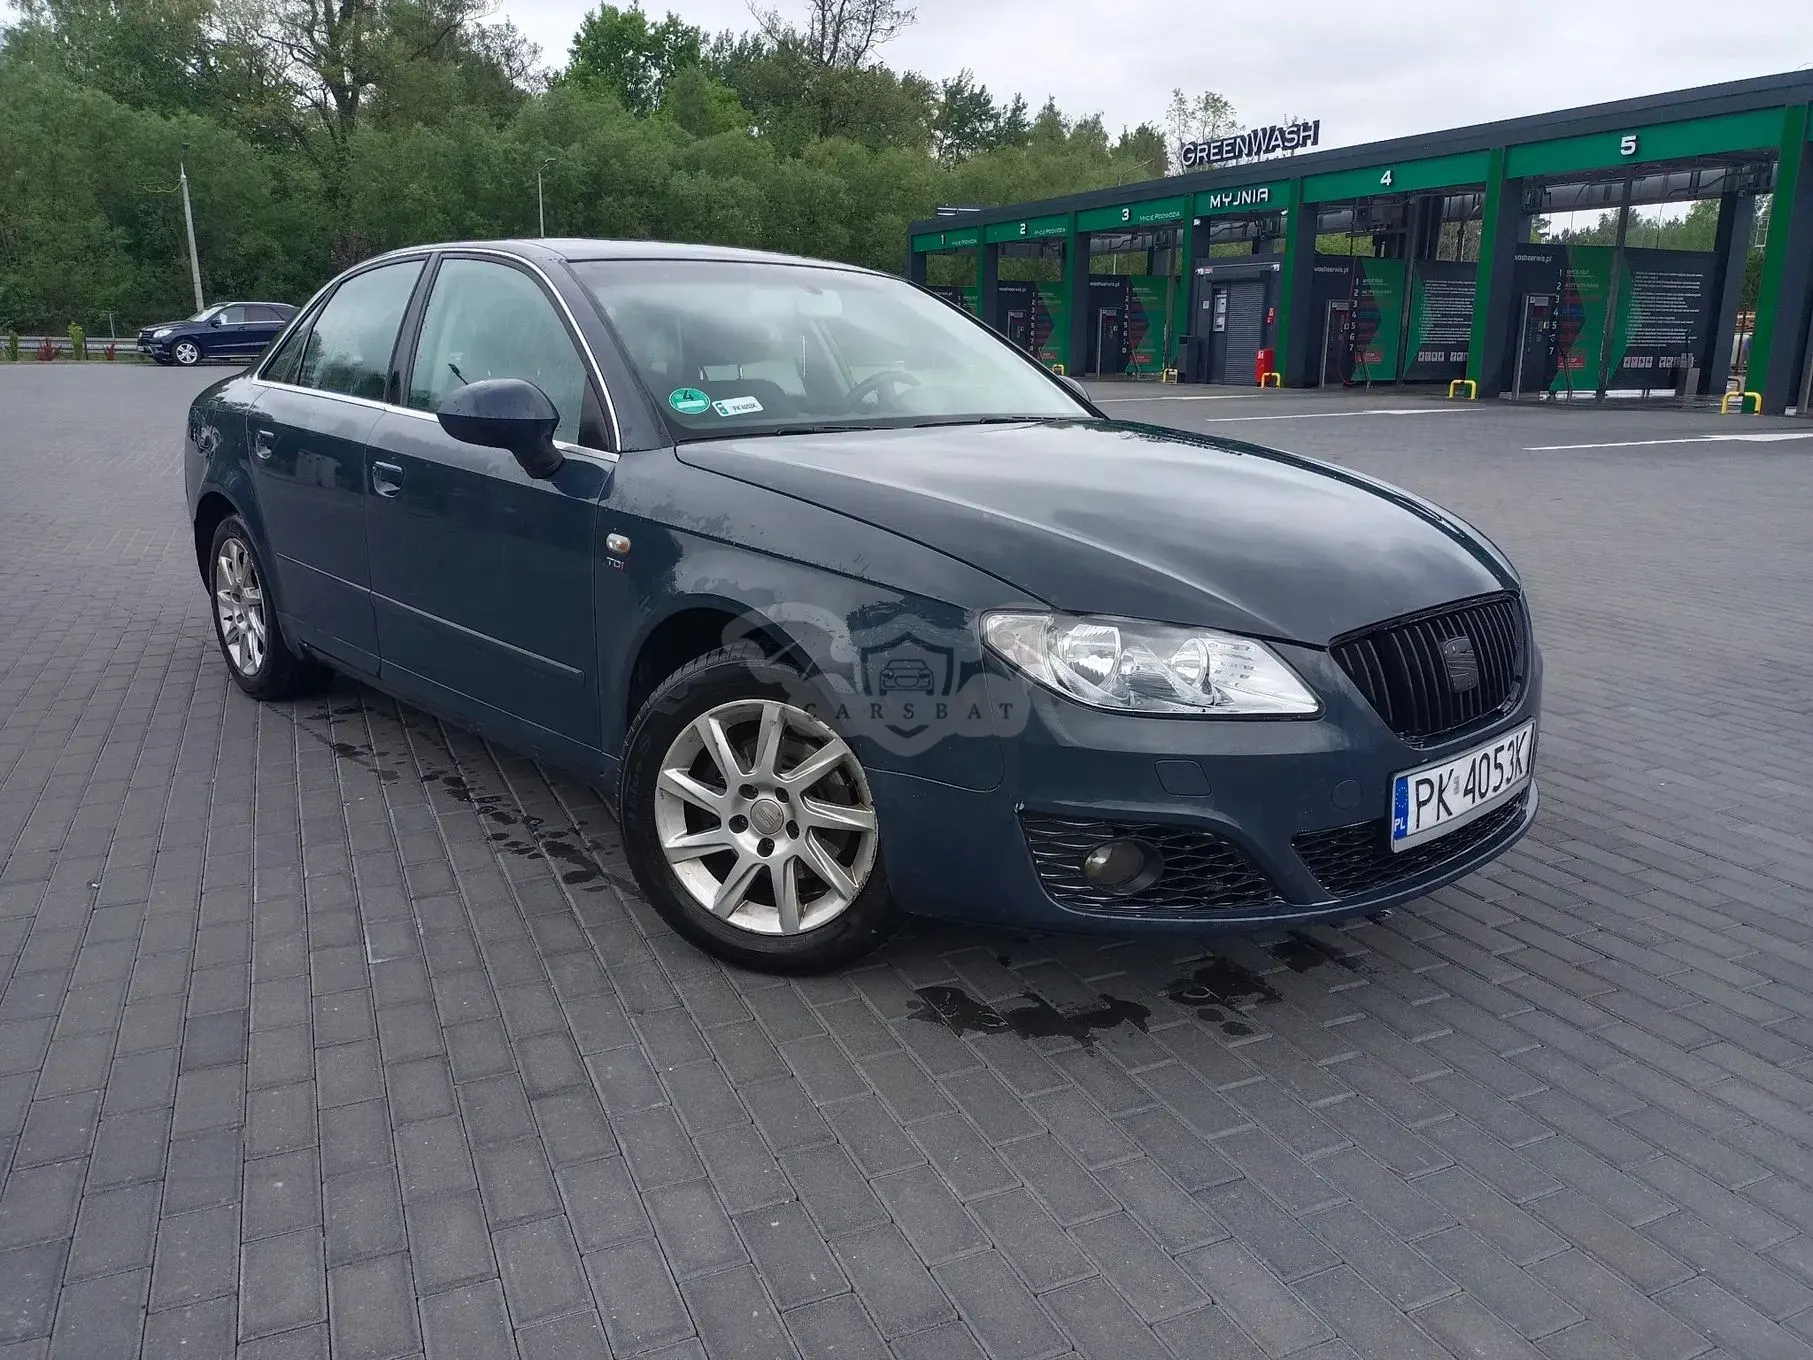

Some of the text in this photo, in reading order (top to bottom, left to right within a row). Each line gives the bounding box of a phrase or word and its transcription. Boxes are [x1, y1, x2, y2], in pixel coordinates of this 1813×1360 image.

[1181, 120, 1320, 168] GREENWASH
[1619, 135, 1639, 156] 5
[1379, 169, 1394, 187] 4
[1209, 187, 1269, 209] MYJNIA
[1121, 207, 1130, 221] 3
[1019, 223, 1026, 235] 2
[940, 234, 945, 245] 1
[1355, 278, 1359, 286] 1
[1556, 282, 1561, 290] 2
[1354, 289, 1359, 297] 2
[1353, 300, 1358, 308] 3
[1555, 295, 1560, 303] 3
[1553, 308, 1559, 316] 4
[1350, 322, 1356, 330] 5
[1551, 321, 1557, 329] 5
[1549, 347, 1554, 355] 7
[682, 390, 694, 401] 4
[1414, 730, 1528, 829] PK 4053K
[1394, 817, 1406, 832] PL
